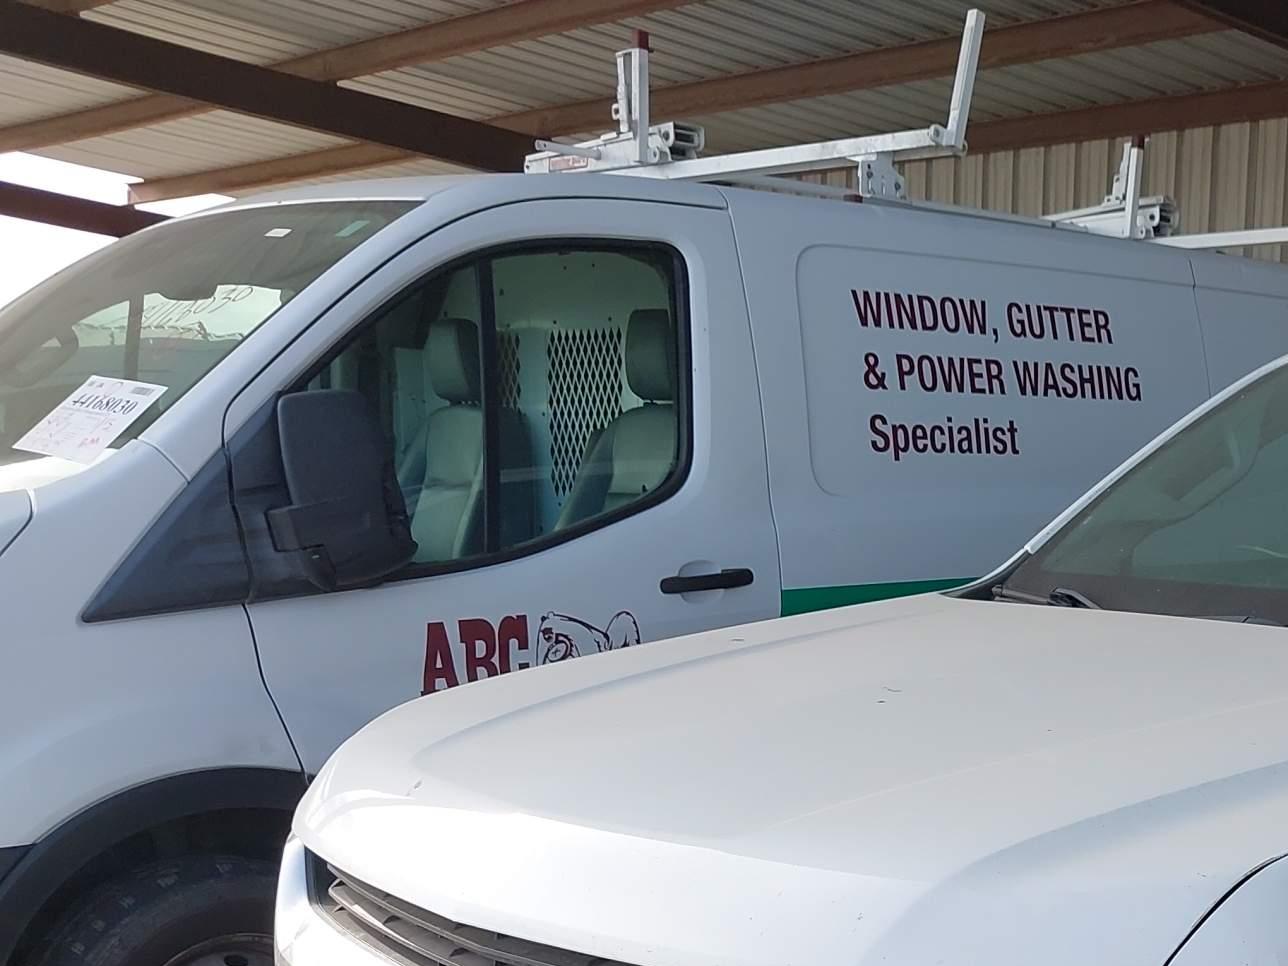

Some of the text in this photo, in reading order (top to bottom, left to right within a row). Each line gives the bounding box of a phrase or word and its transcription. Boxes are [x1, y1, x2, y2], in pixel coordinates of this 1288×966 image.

[851, 289, 1113, 344] WINDOW, GUTTER
[863, 352, 1142, 401] & POWER WASHING
[869, 414, 1020, 461] Specialist
